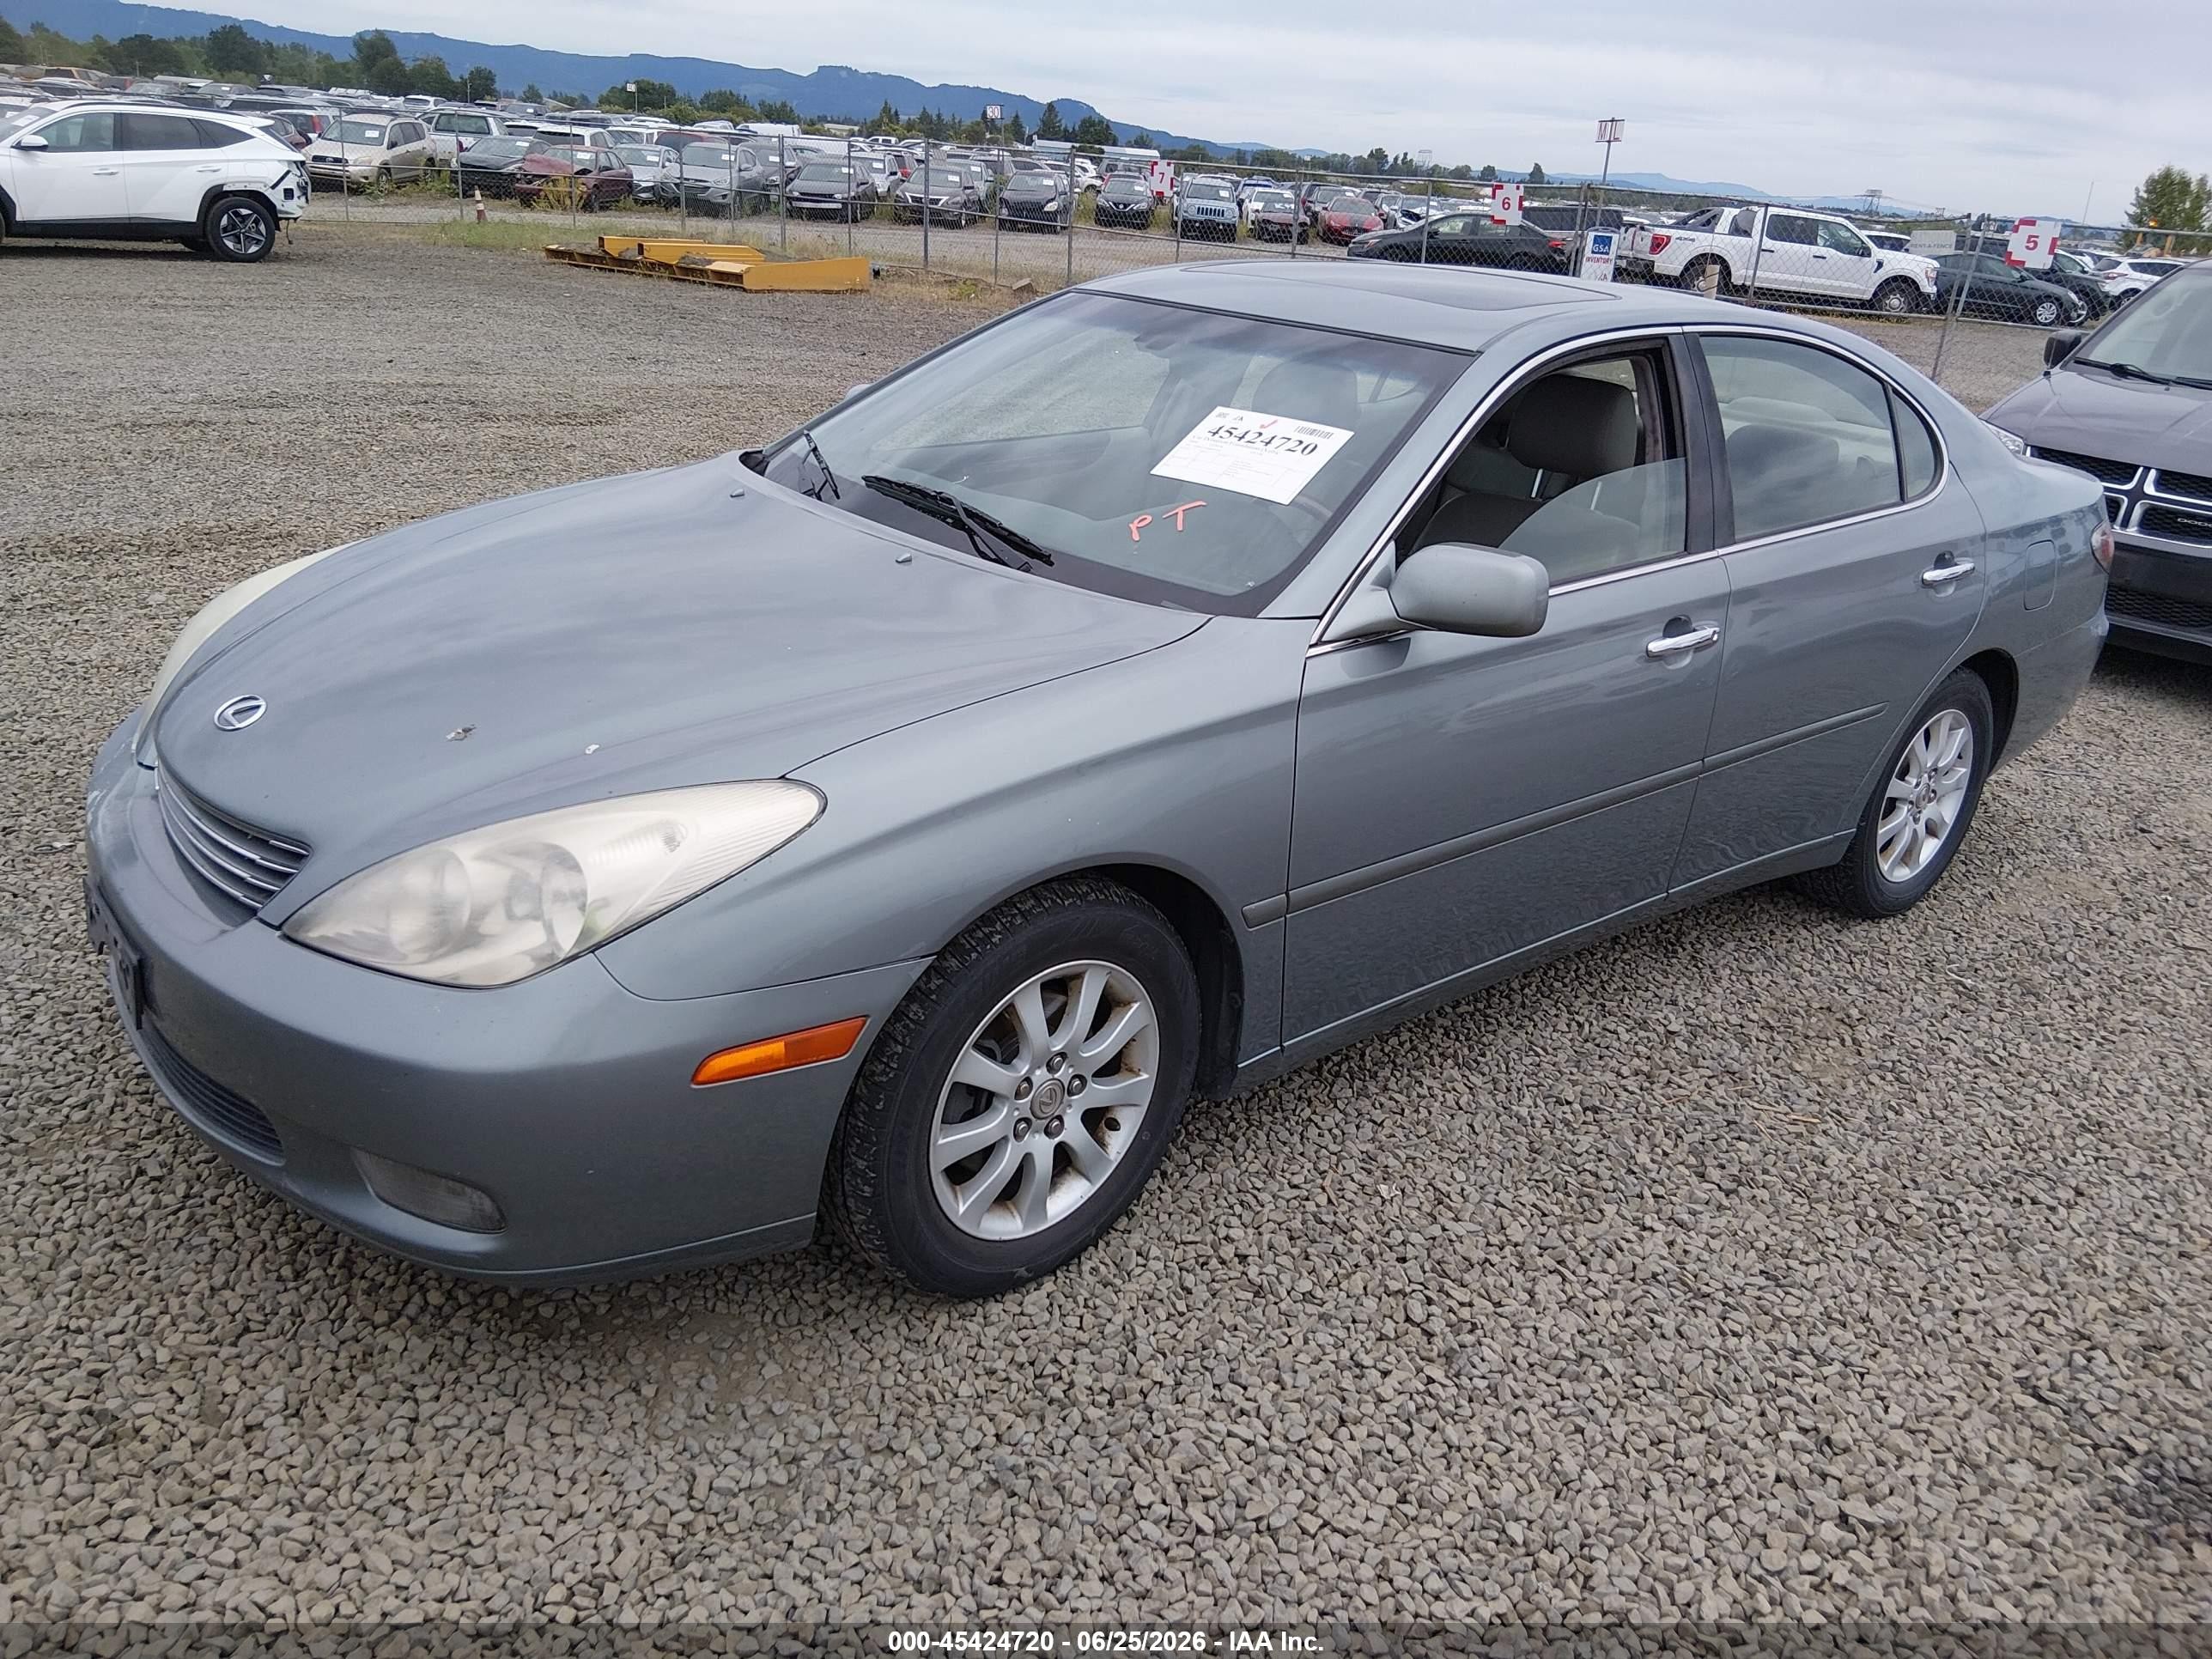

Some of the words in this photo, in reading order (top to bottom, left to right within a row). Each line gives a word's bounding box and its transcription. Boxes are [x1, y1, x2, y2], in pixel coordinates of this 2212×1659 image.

[988, 106, 1000, 118] 30
[1158, 172, 1165, 184] 7
[1502, 197, 1511, 211] 6
[1592, 244, 1610, 253] GSA
[2025, 234, 2039, 251] 5
[1207, 425, 1318, 456] 45424720
